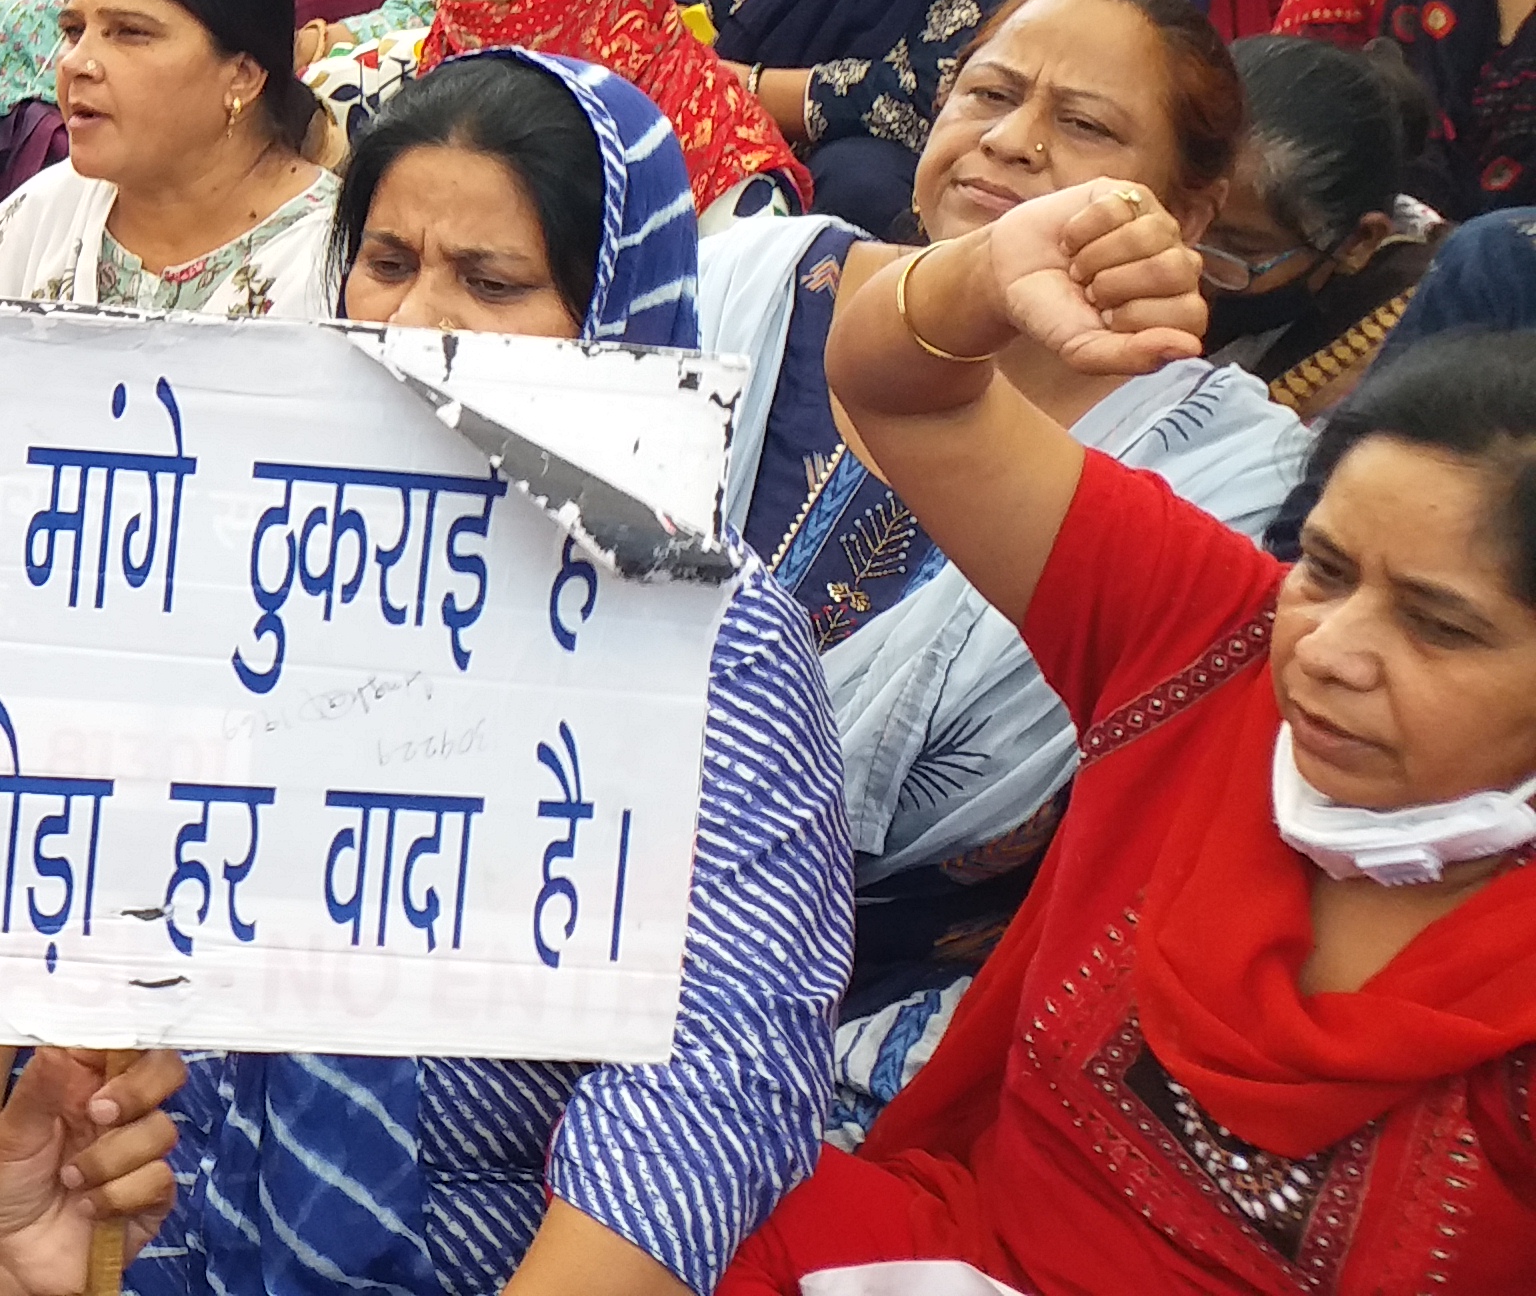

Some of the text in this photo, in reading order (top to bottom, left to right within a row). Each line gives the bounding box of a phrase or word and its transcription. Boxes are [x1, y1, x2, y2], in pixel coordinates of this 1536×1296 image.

[24, 376, 197, 612] मांगे
[550, 533, 597, 652] ह
[167, 784, 275, 955] हर
[325, 790, 483, 952] वादा
